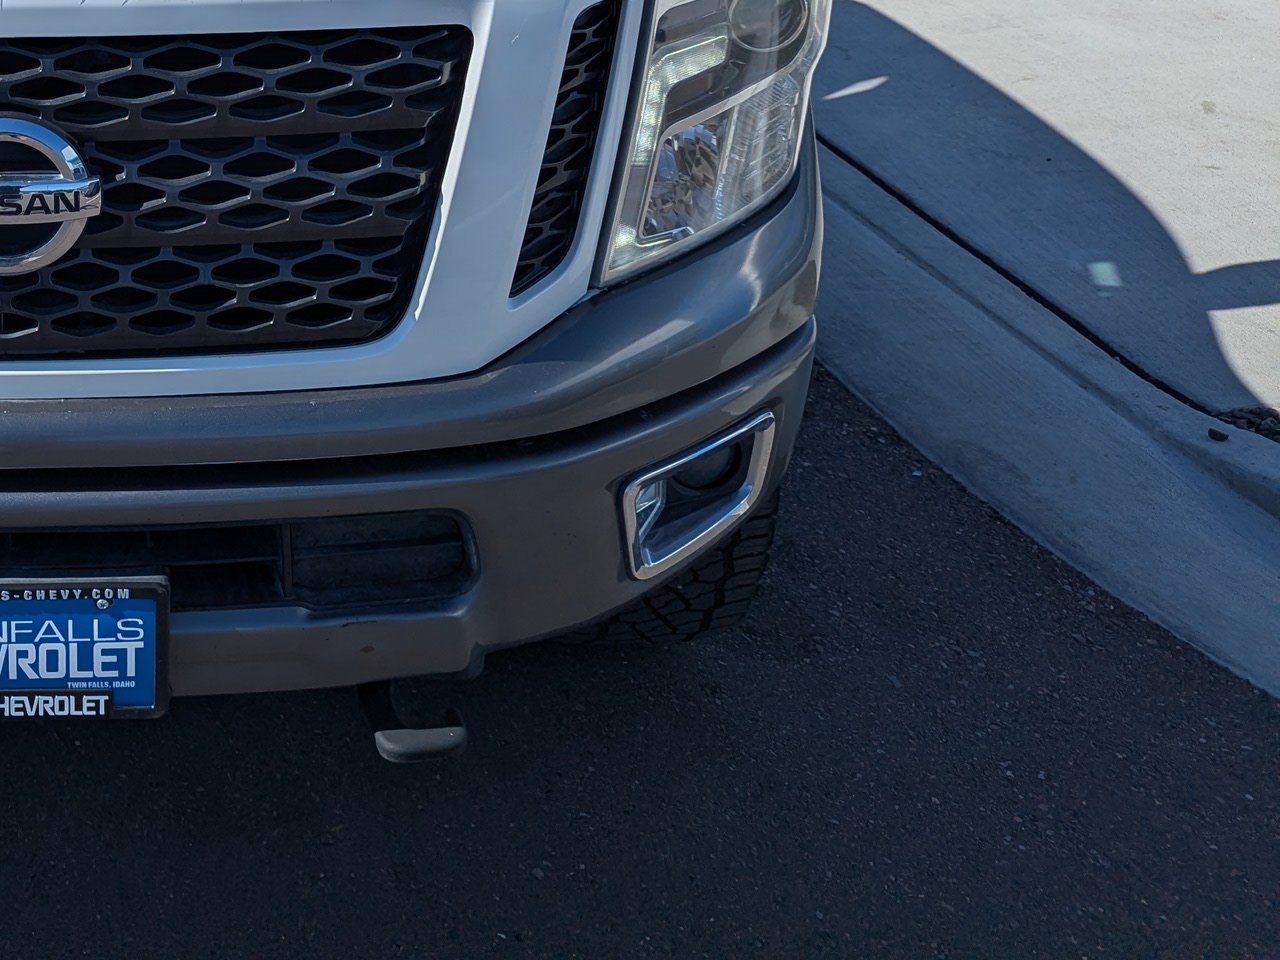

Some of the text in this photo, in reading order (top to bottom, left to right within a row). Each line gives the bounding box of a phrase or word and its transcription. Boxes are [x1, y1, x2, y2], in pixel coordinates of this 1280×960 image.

[67, 680, 136, 689] TWIN FALLS, IDAHO
